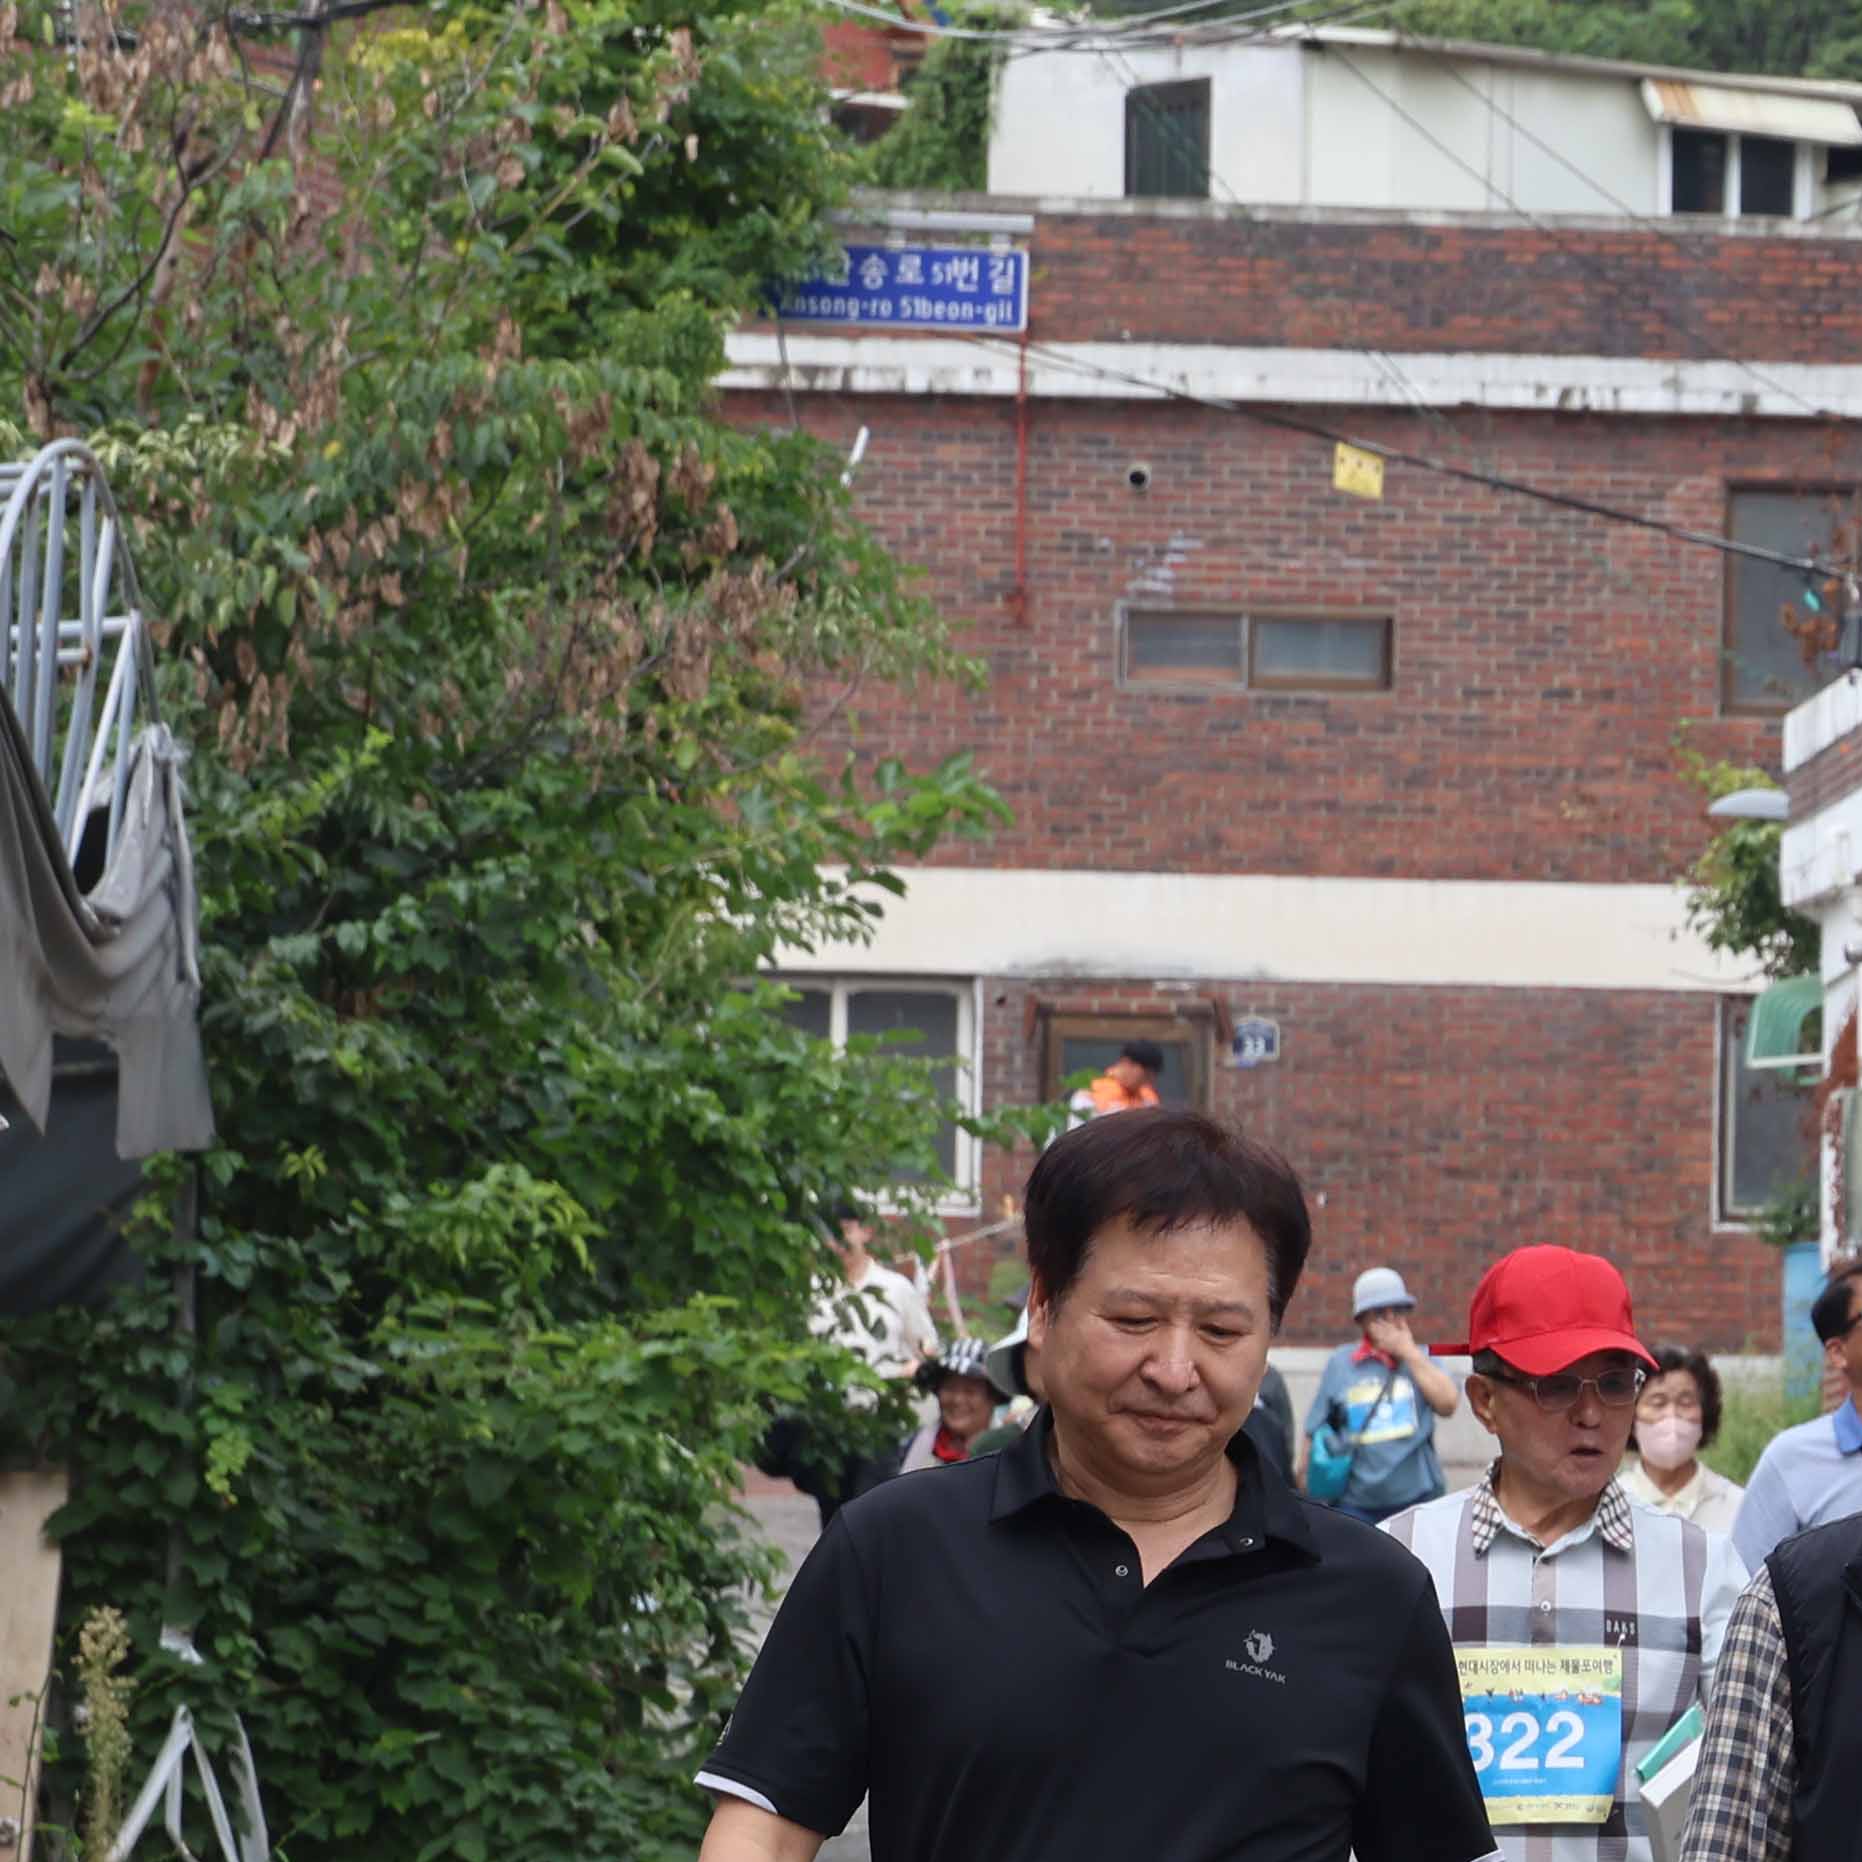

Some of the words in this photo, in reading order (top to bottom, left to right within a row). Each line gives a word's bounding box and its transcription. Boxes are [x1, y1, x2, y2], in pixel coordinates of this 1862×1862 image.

[900, 298, 1014, 325] 51beon-gil
[1225, 1659, 1263, 1677] BLACK
[1264, 1669, 1287, 1685] YAK
